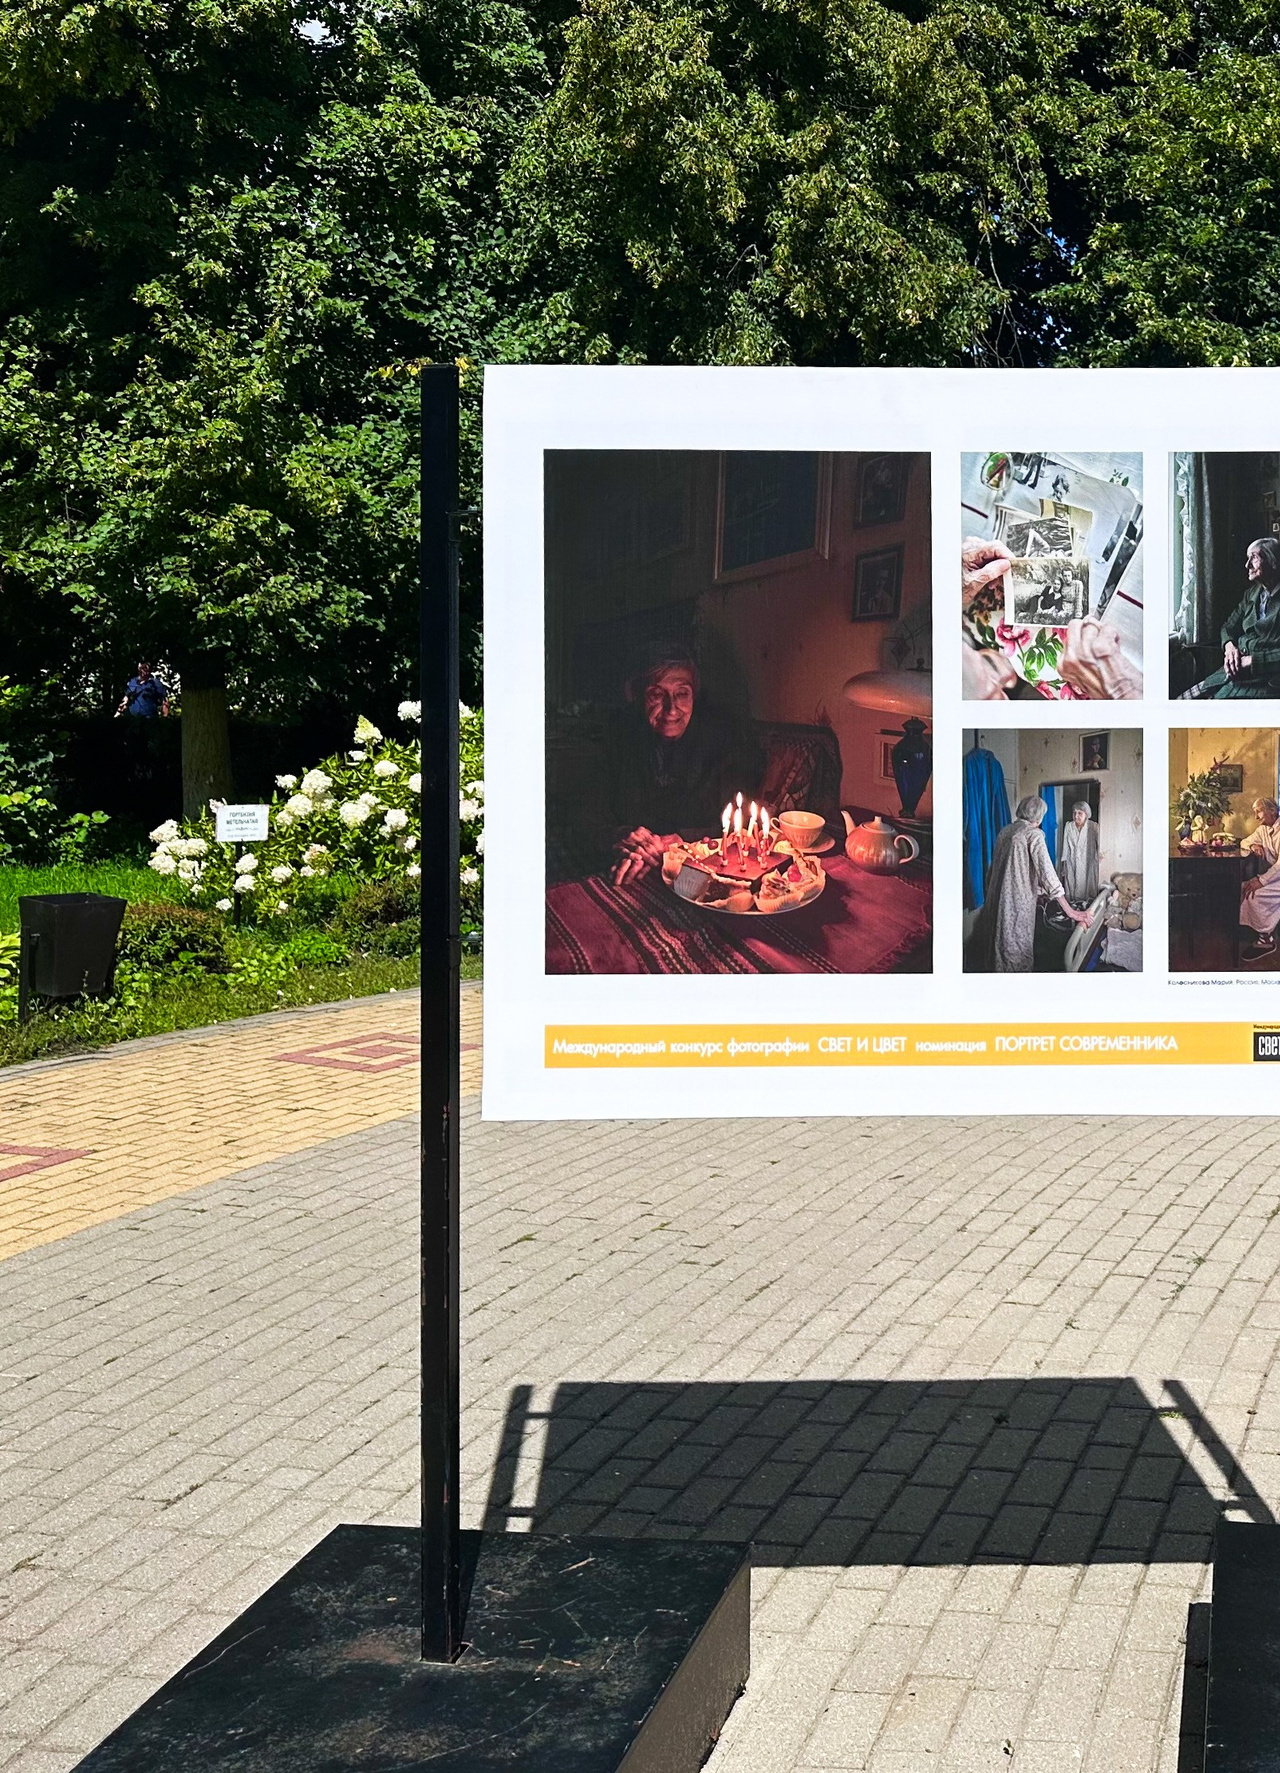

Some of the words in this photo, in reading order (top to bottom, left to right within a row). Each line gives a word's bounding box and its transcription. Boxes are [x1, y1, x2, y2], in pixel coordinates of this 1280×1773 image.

[552, 1038, 666, 1058] Международный
[670, 1041, 723, 1057] конкурс
[727, 1037, 810, 1057] фотографии
[817, 1036, 852, 1053] СВЕТ
[856, 1036, 869, 1053] И
[872, 1036, 907, 1055] ЦВЕТ
[915, 1040, 987, 1054] номинация
[995, 1035, 1056, 1052] ПОРТРЕТ
[1059, 1035, 1179, 1052] СОВРЕМЕННИКА
